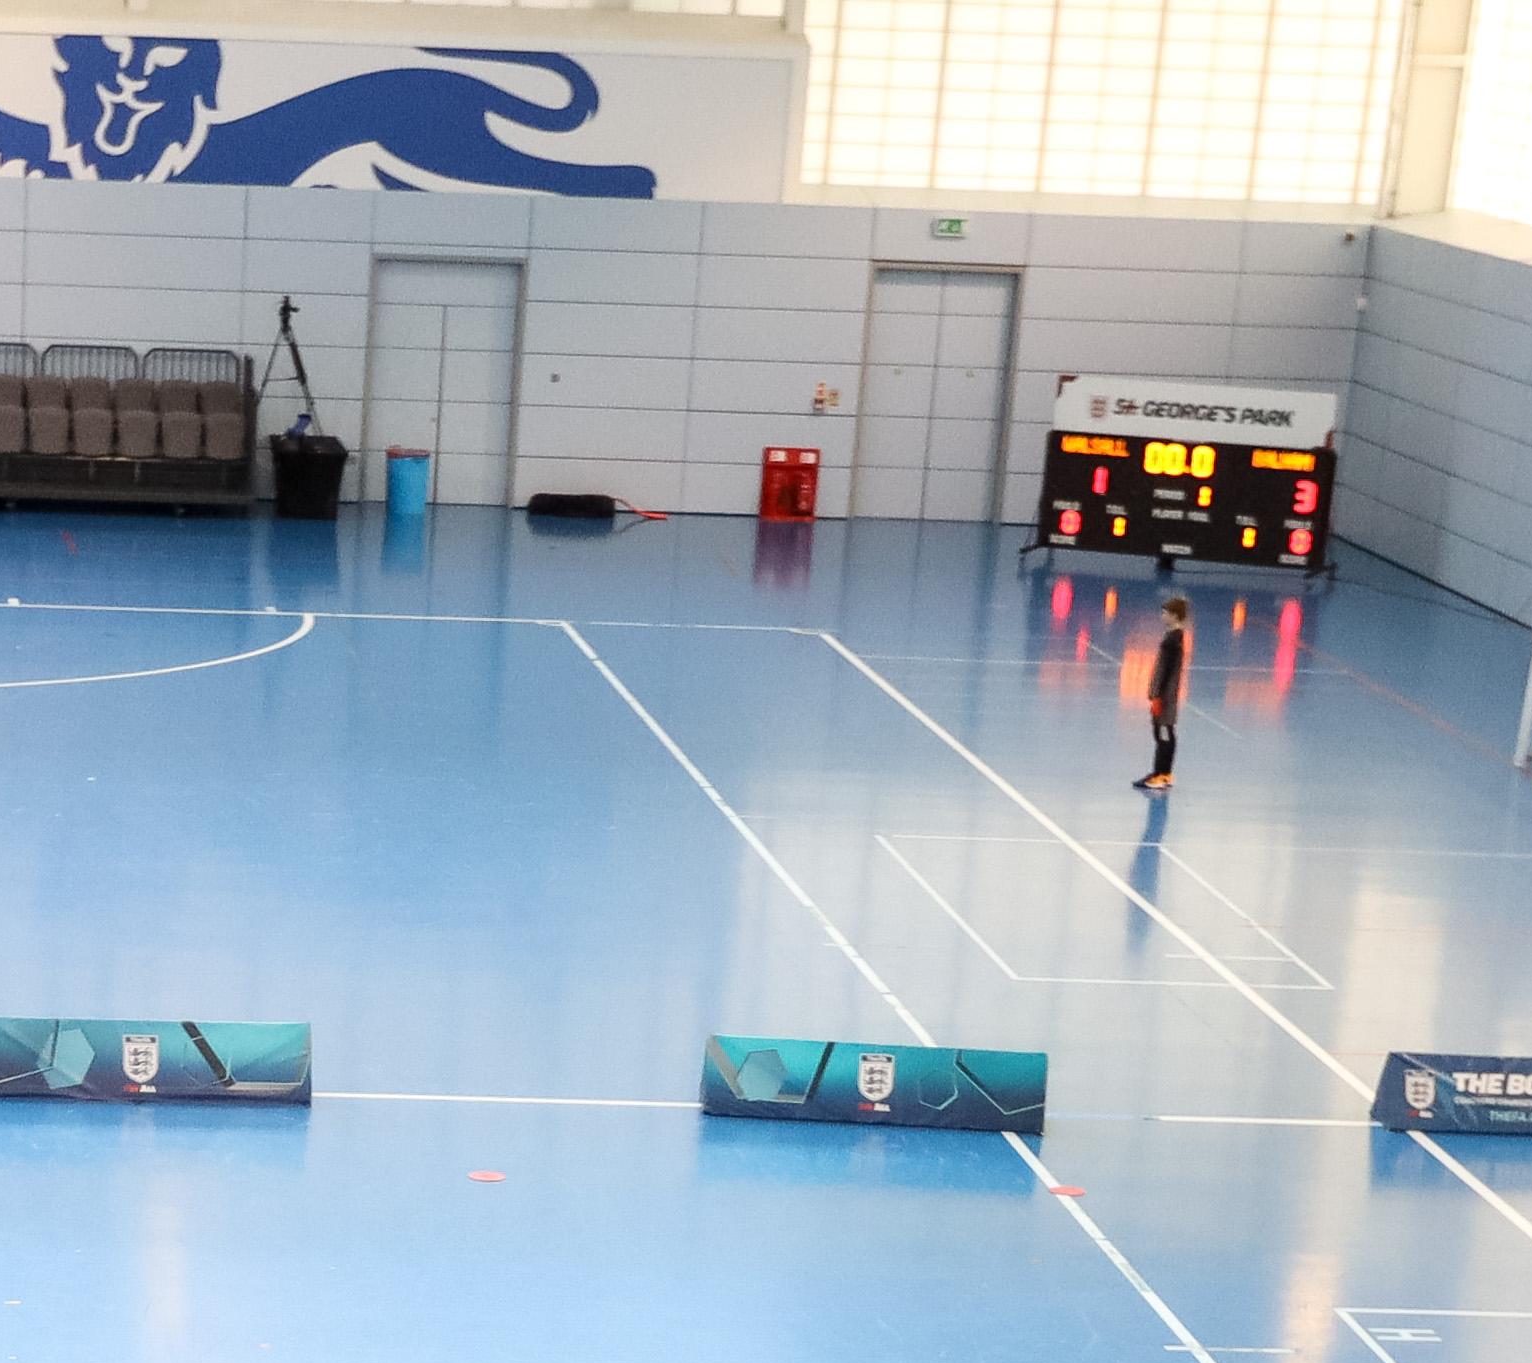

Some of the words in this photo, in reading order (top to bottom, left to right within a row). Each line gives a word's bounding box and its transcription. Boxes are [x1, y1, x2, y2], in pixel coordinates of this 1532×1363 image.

[1239, 408, 1295, 428] PARK
[1292, 479, 1319, 515] 3
[1452, 1072, 1506, 1095] THE
